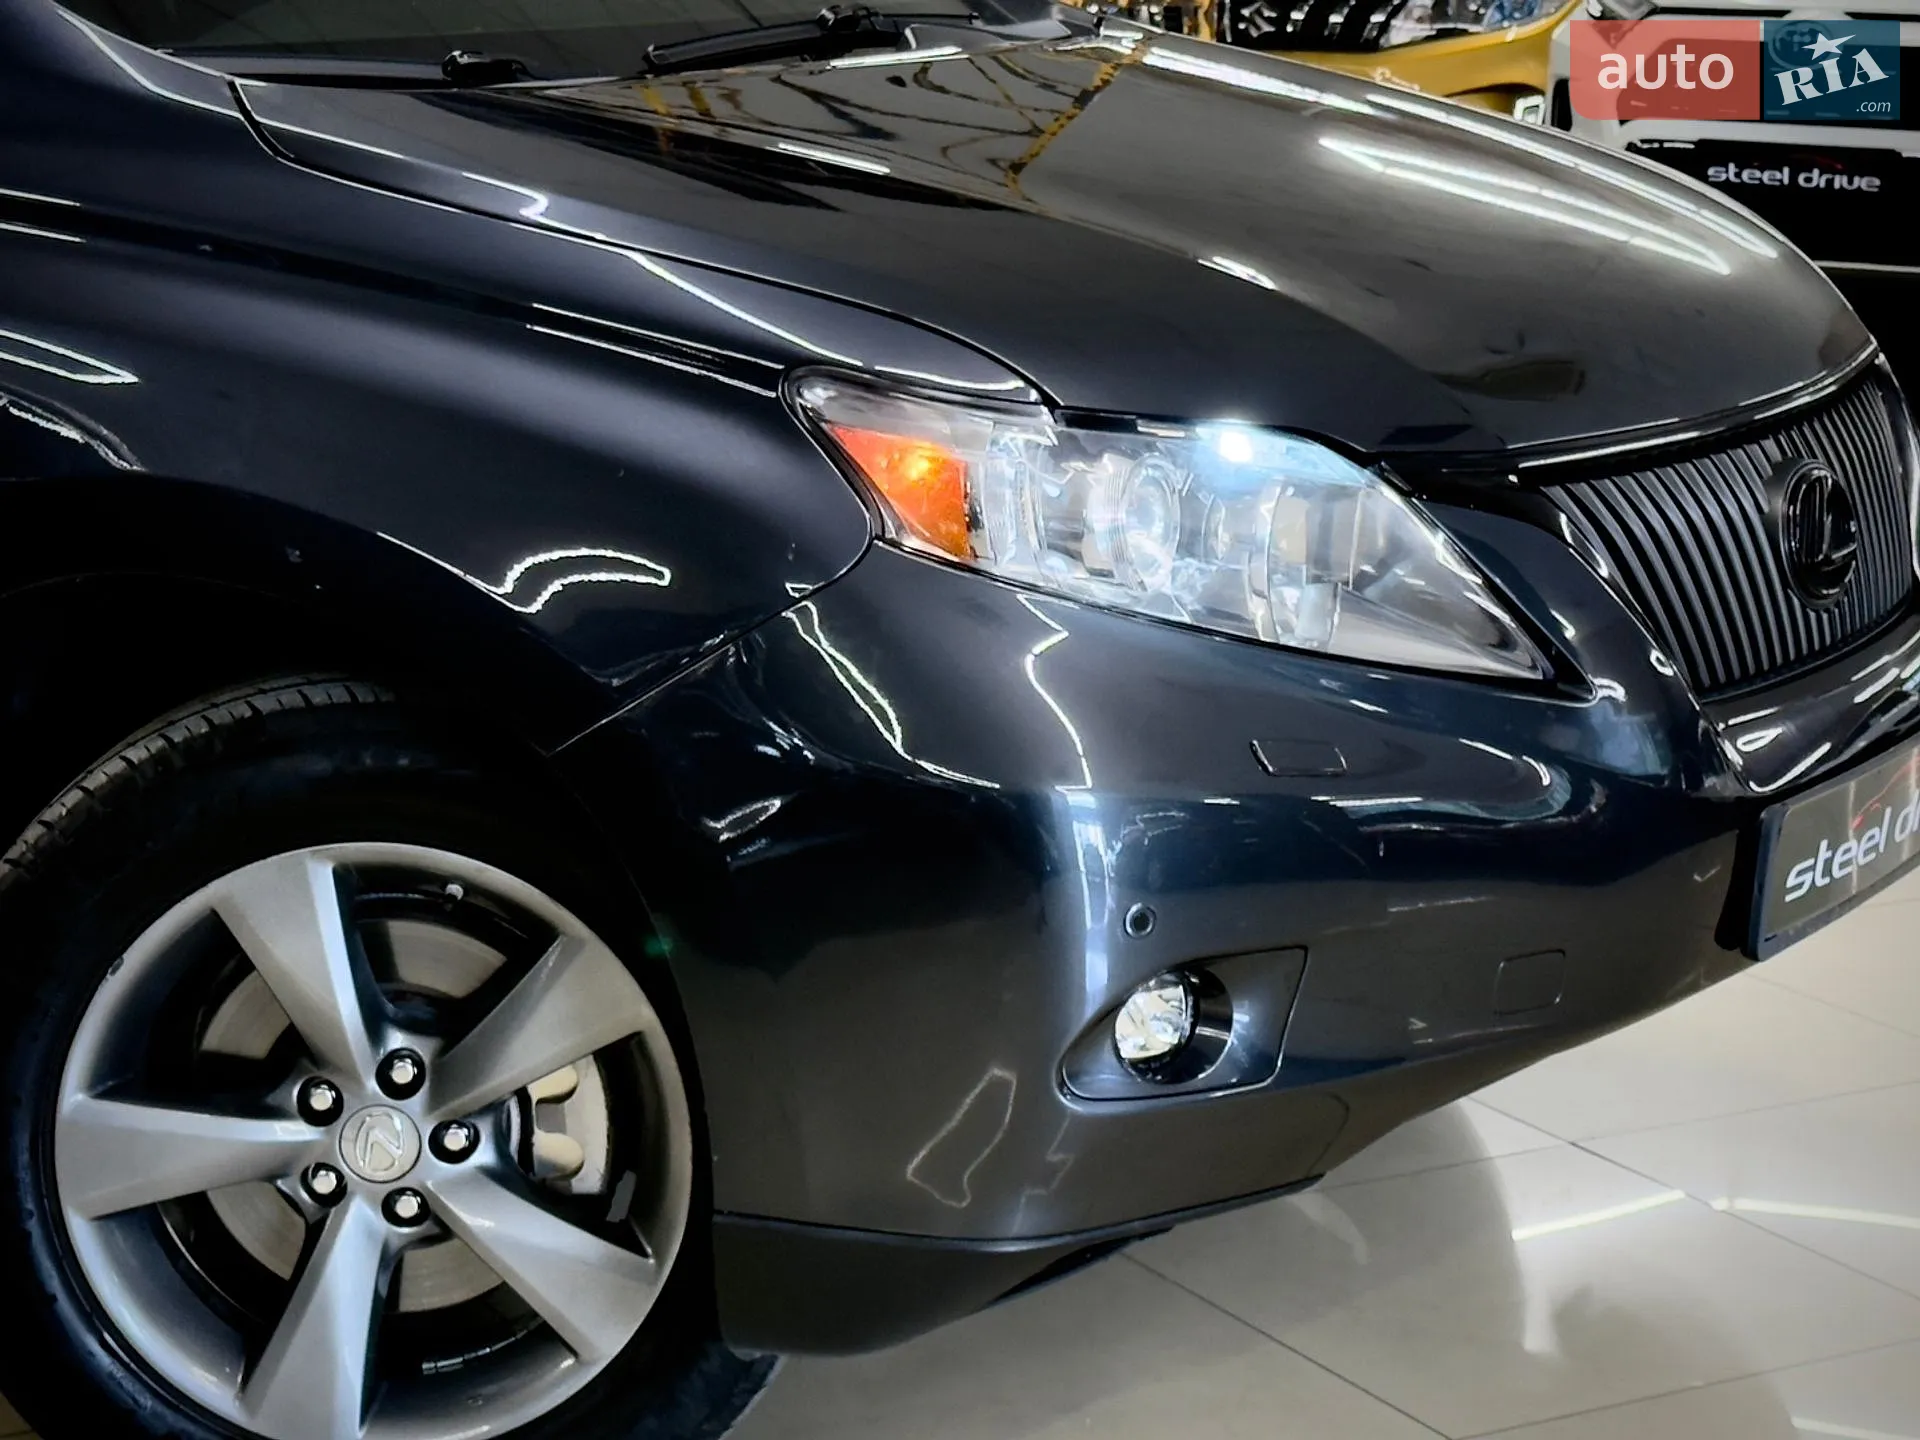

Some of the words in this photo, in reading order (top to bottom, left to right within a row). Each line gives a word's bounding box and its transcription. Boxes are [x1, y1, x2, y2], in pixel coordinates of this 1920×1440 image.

[1707, 162, 1790, 186] steel
[1797, 168, 1882, 192] drive
[1784, 805, 1892, 902] steel
